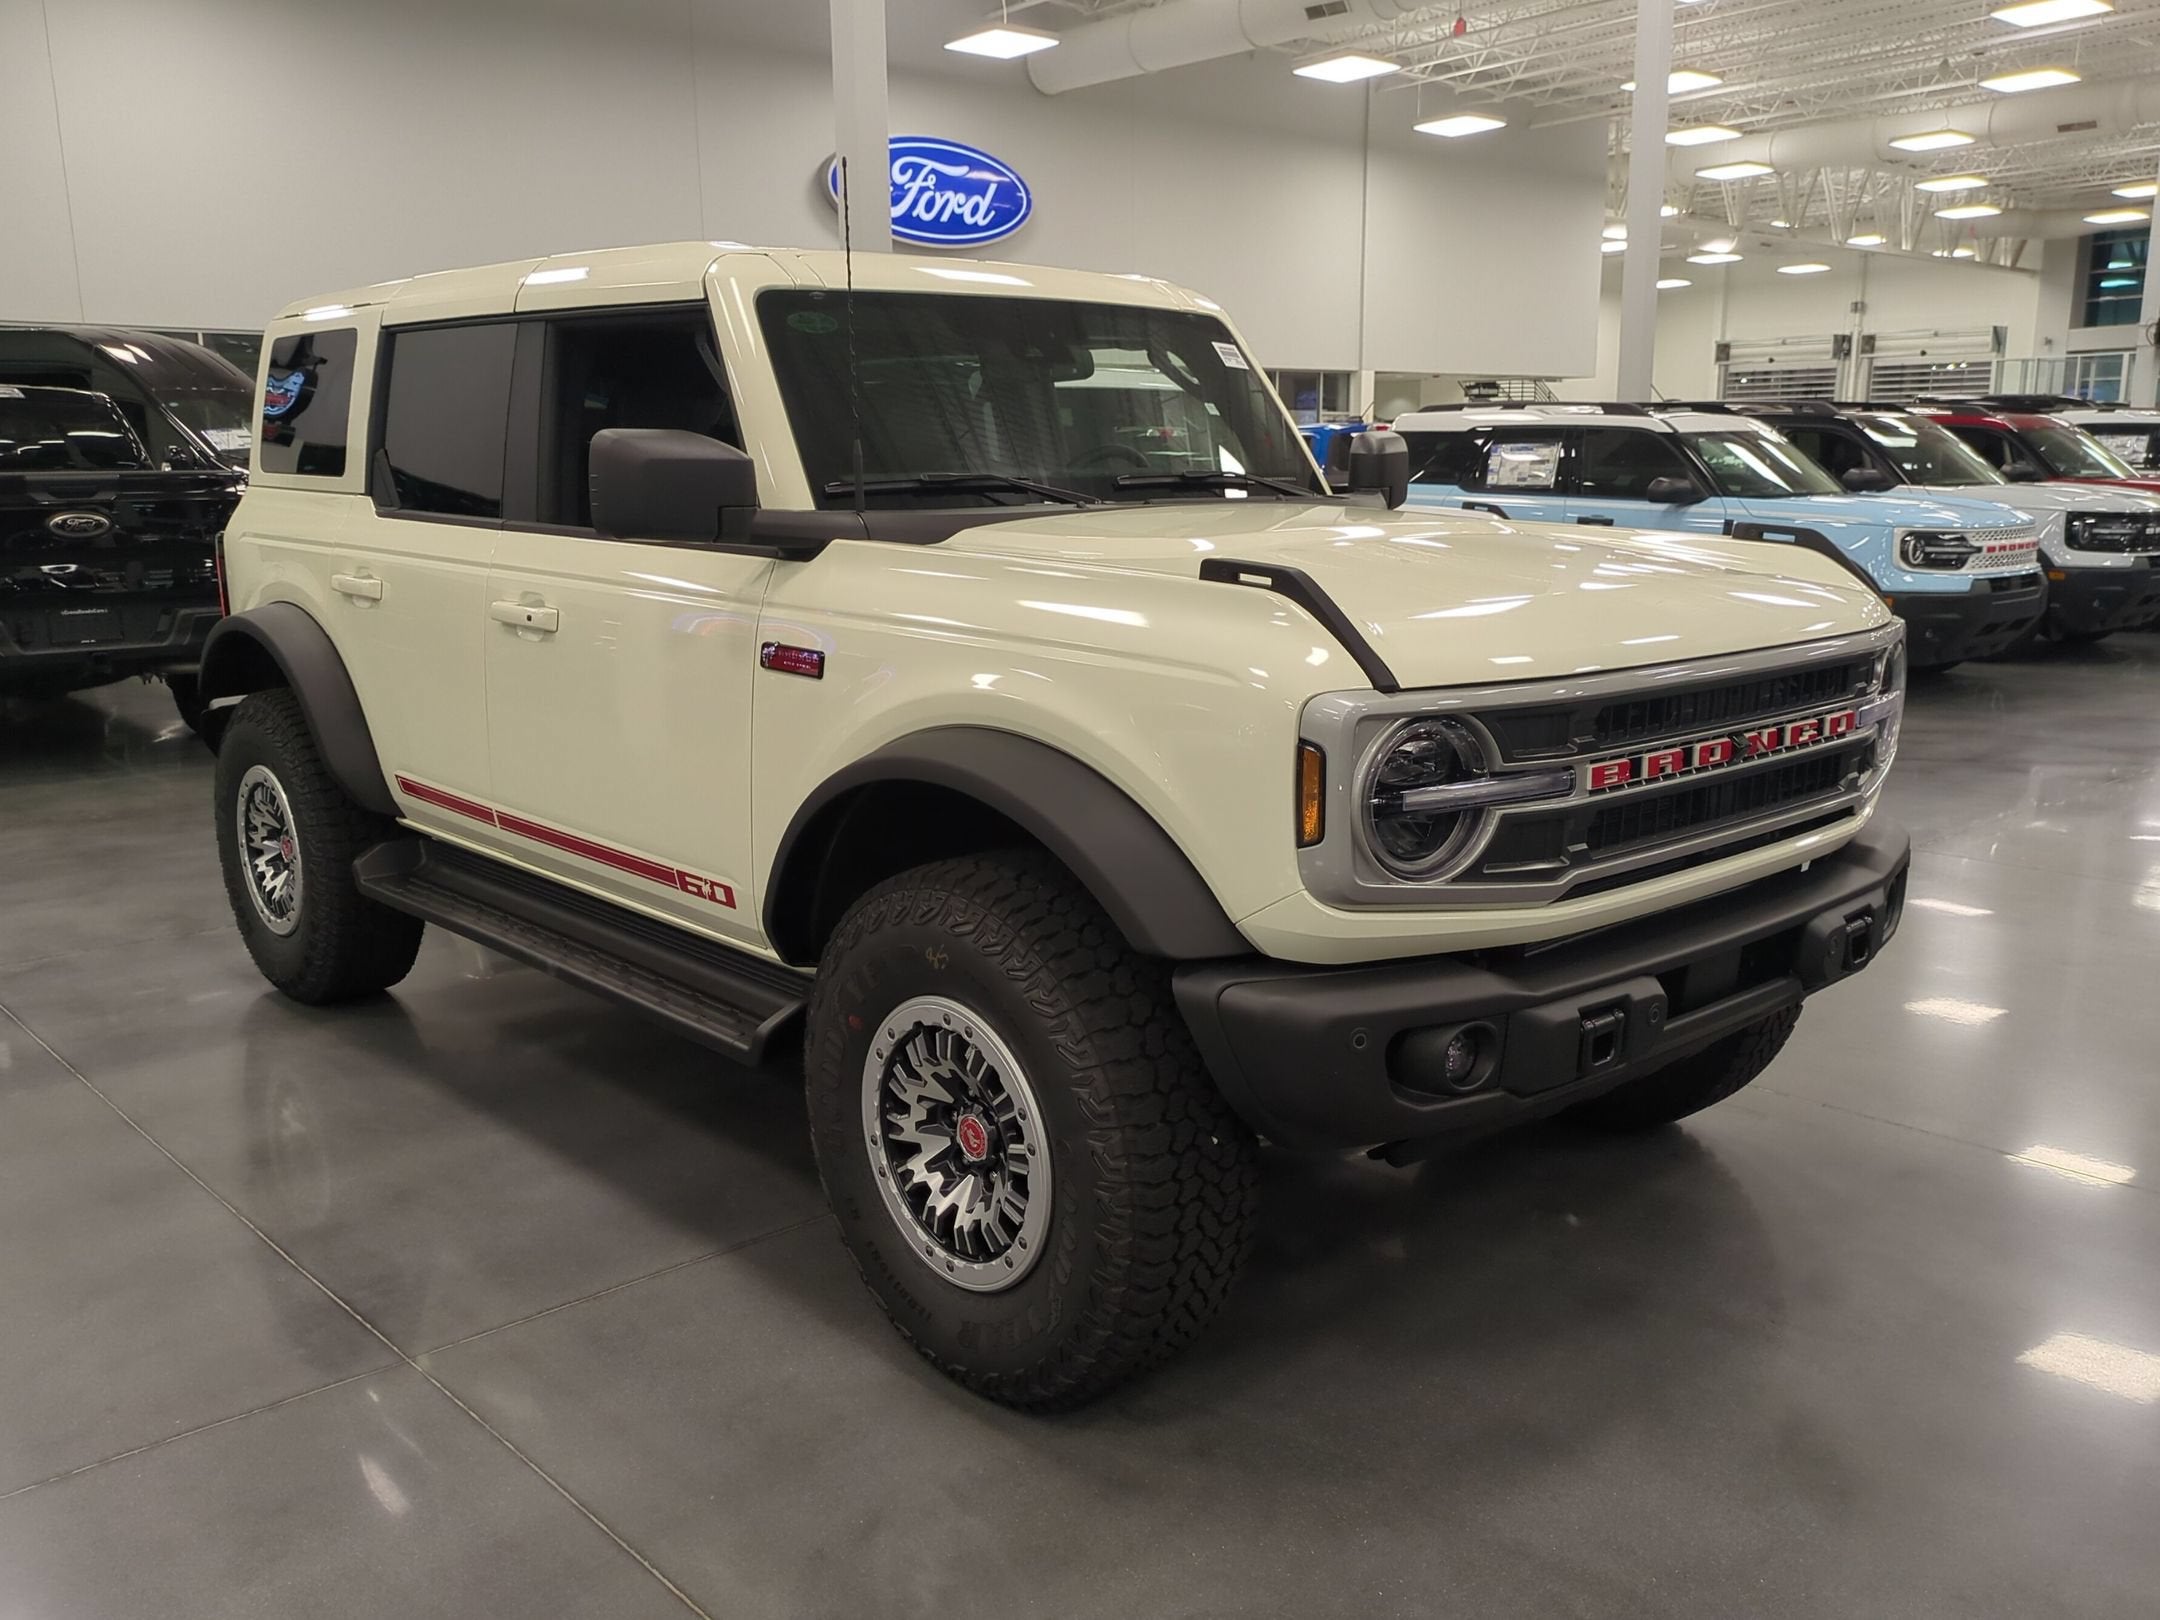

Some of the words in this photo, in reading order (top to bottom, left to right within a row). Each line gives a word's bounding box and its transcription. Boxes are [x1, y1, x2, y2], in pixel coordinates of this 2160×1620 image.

[890, 156, 998, 226] Ford
[1587, 710, 1856, 790] BRONCO
[676, 869, 736, 909] 60
